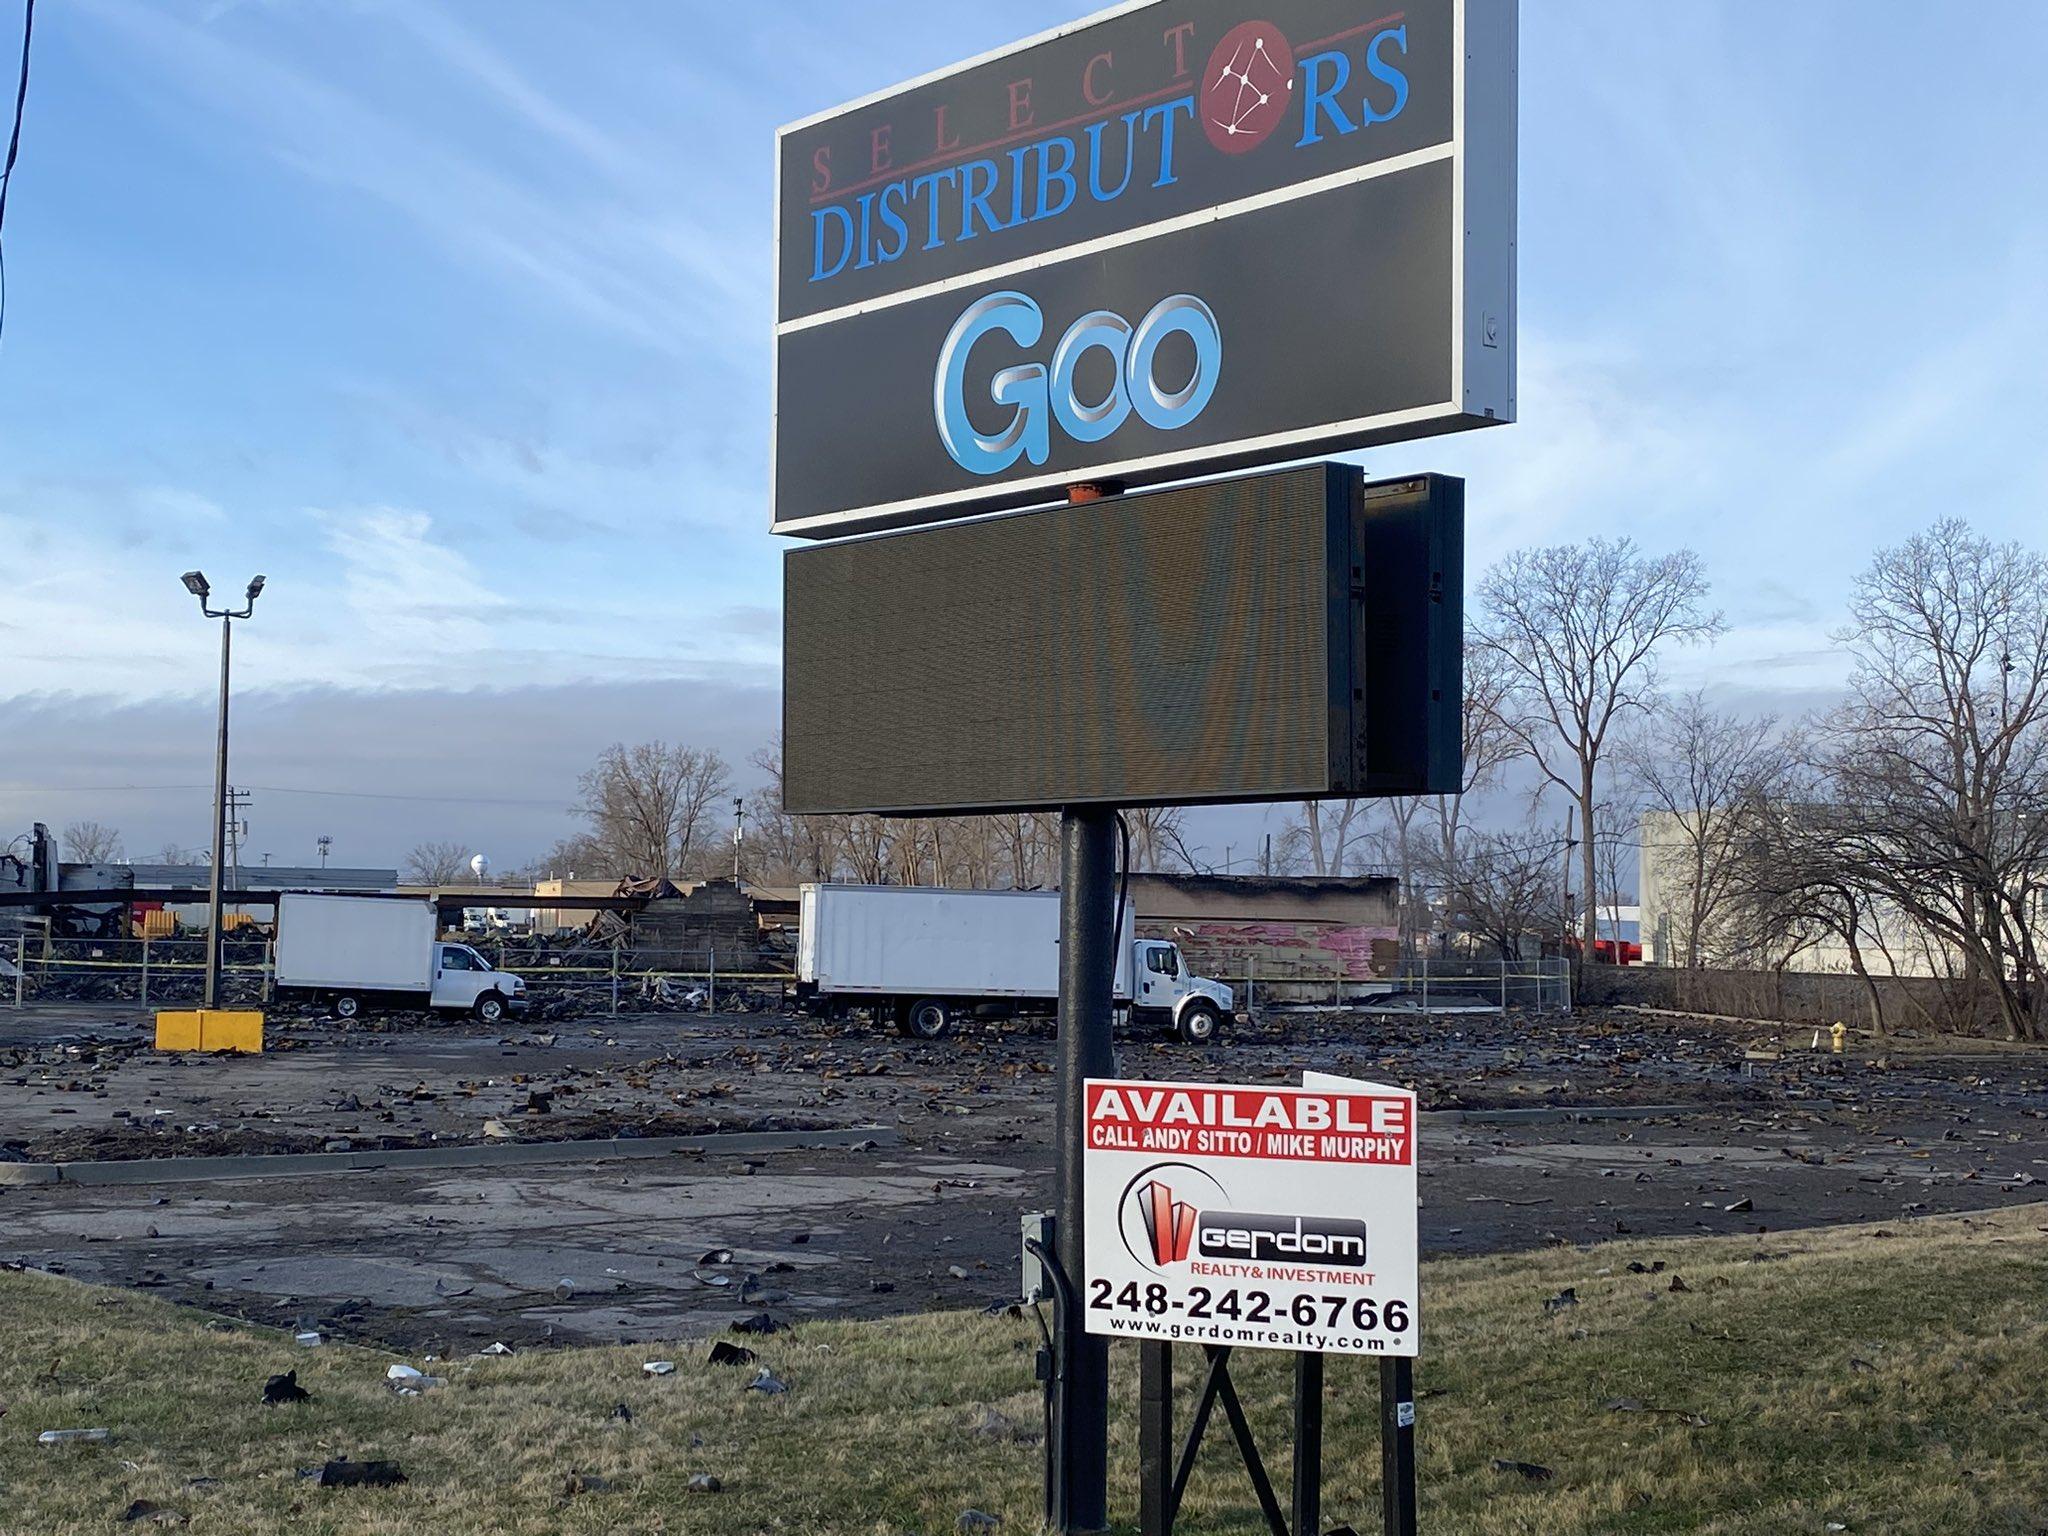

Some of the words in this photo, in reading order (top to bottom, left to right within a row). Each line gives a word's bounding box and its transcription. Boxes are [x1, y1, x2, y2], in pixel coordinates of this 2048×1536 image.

[811, 22, 1195, 194] SELECT
[1091, 1088, 1406, 1133] AVAILABLE
[1092, 1124, 1138, 1147] CALL
[1142, 1127, 1193, 1150] ANDY
[1197, 1130, 1251, 1154] SITTO
[1267, 1133, 1315, 1157] MIKE
[1320, 1135, 1405, 1161] MURPHY
[1266, 1267, 1377, 1287] INVESTMENT
[1089, 1278, 1410, 1333] 248-242-6766
[1109, 1318, 1386, 1350] www.gerdomrealty.com
